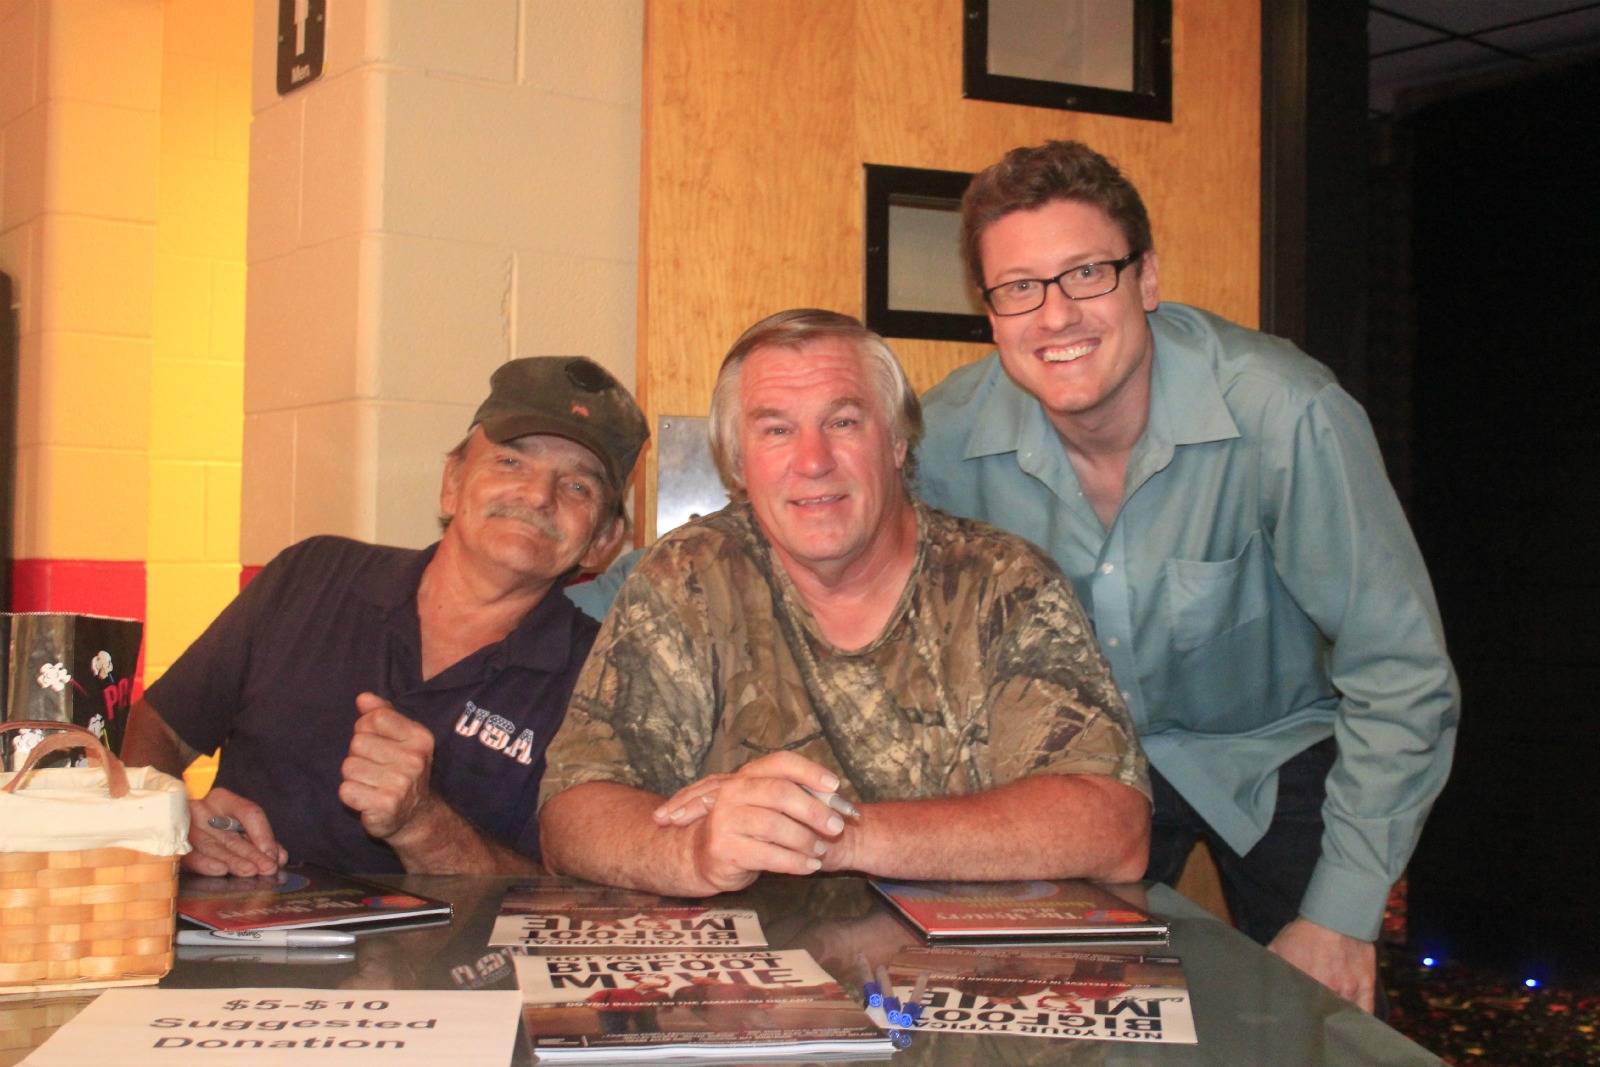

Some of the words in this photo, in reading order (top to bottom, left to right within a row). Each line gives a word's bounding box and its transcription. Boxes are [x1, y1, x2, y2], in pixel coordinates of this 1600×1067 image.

[455, 700, 535, 765] USA
[519, 929, 738, 940] BIGFOOT
[679, 952, 781, 960] TYPICAL
[547, 957, 783, 974] BIGFOOT
[222, 1000, 390, 1011] $5-$10
[150, 1017, 438, 1031] Suggested
[912, 1020, 1012, 1031] TYPICA
[1020, 1025, 1099, 1037] YOUR
[1105, 1030, 1163, 1040] NOT
[153, 1036, 406, 1049] Donation
